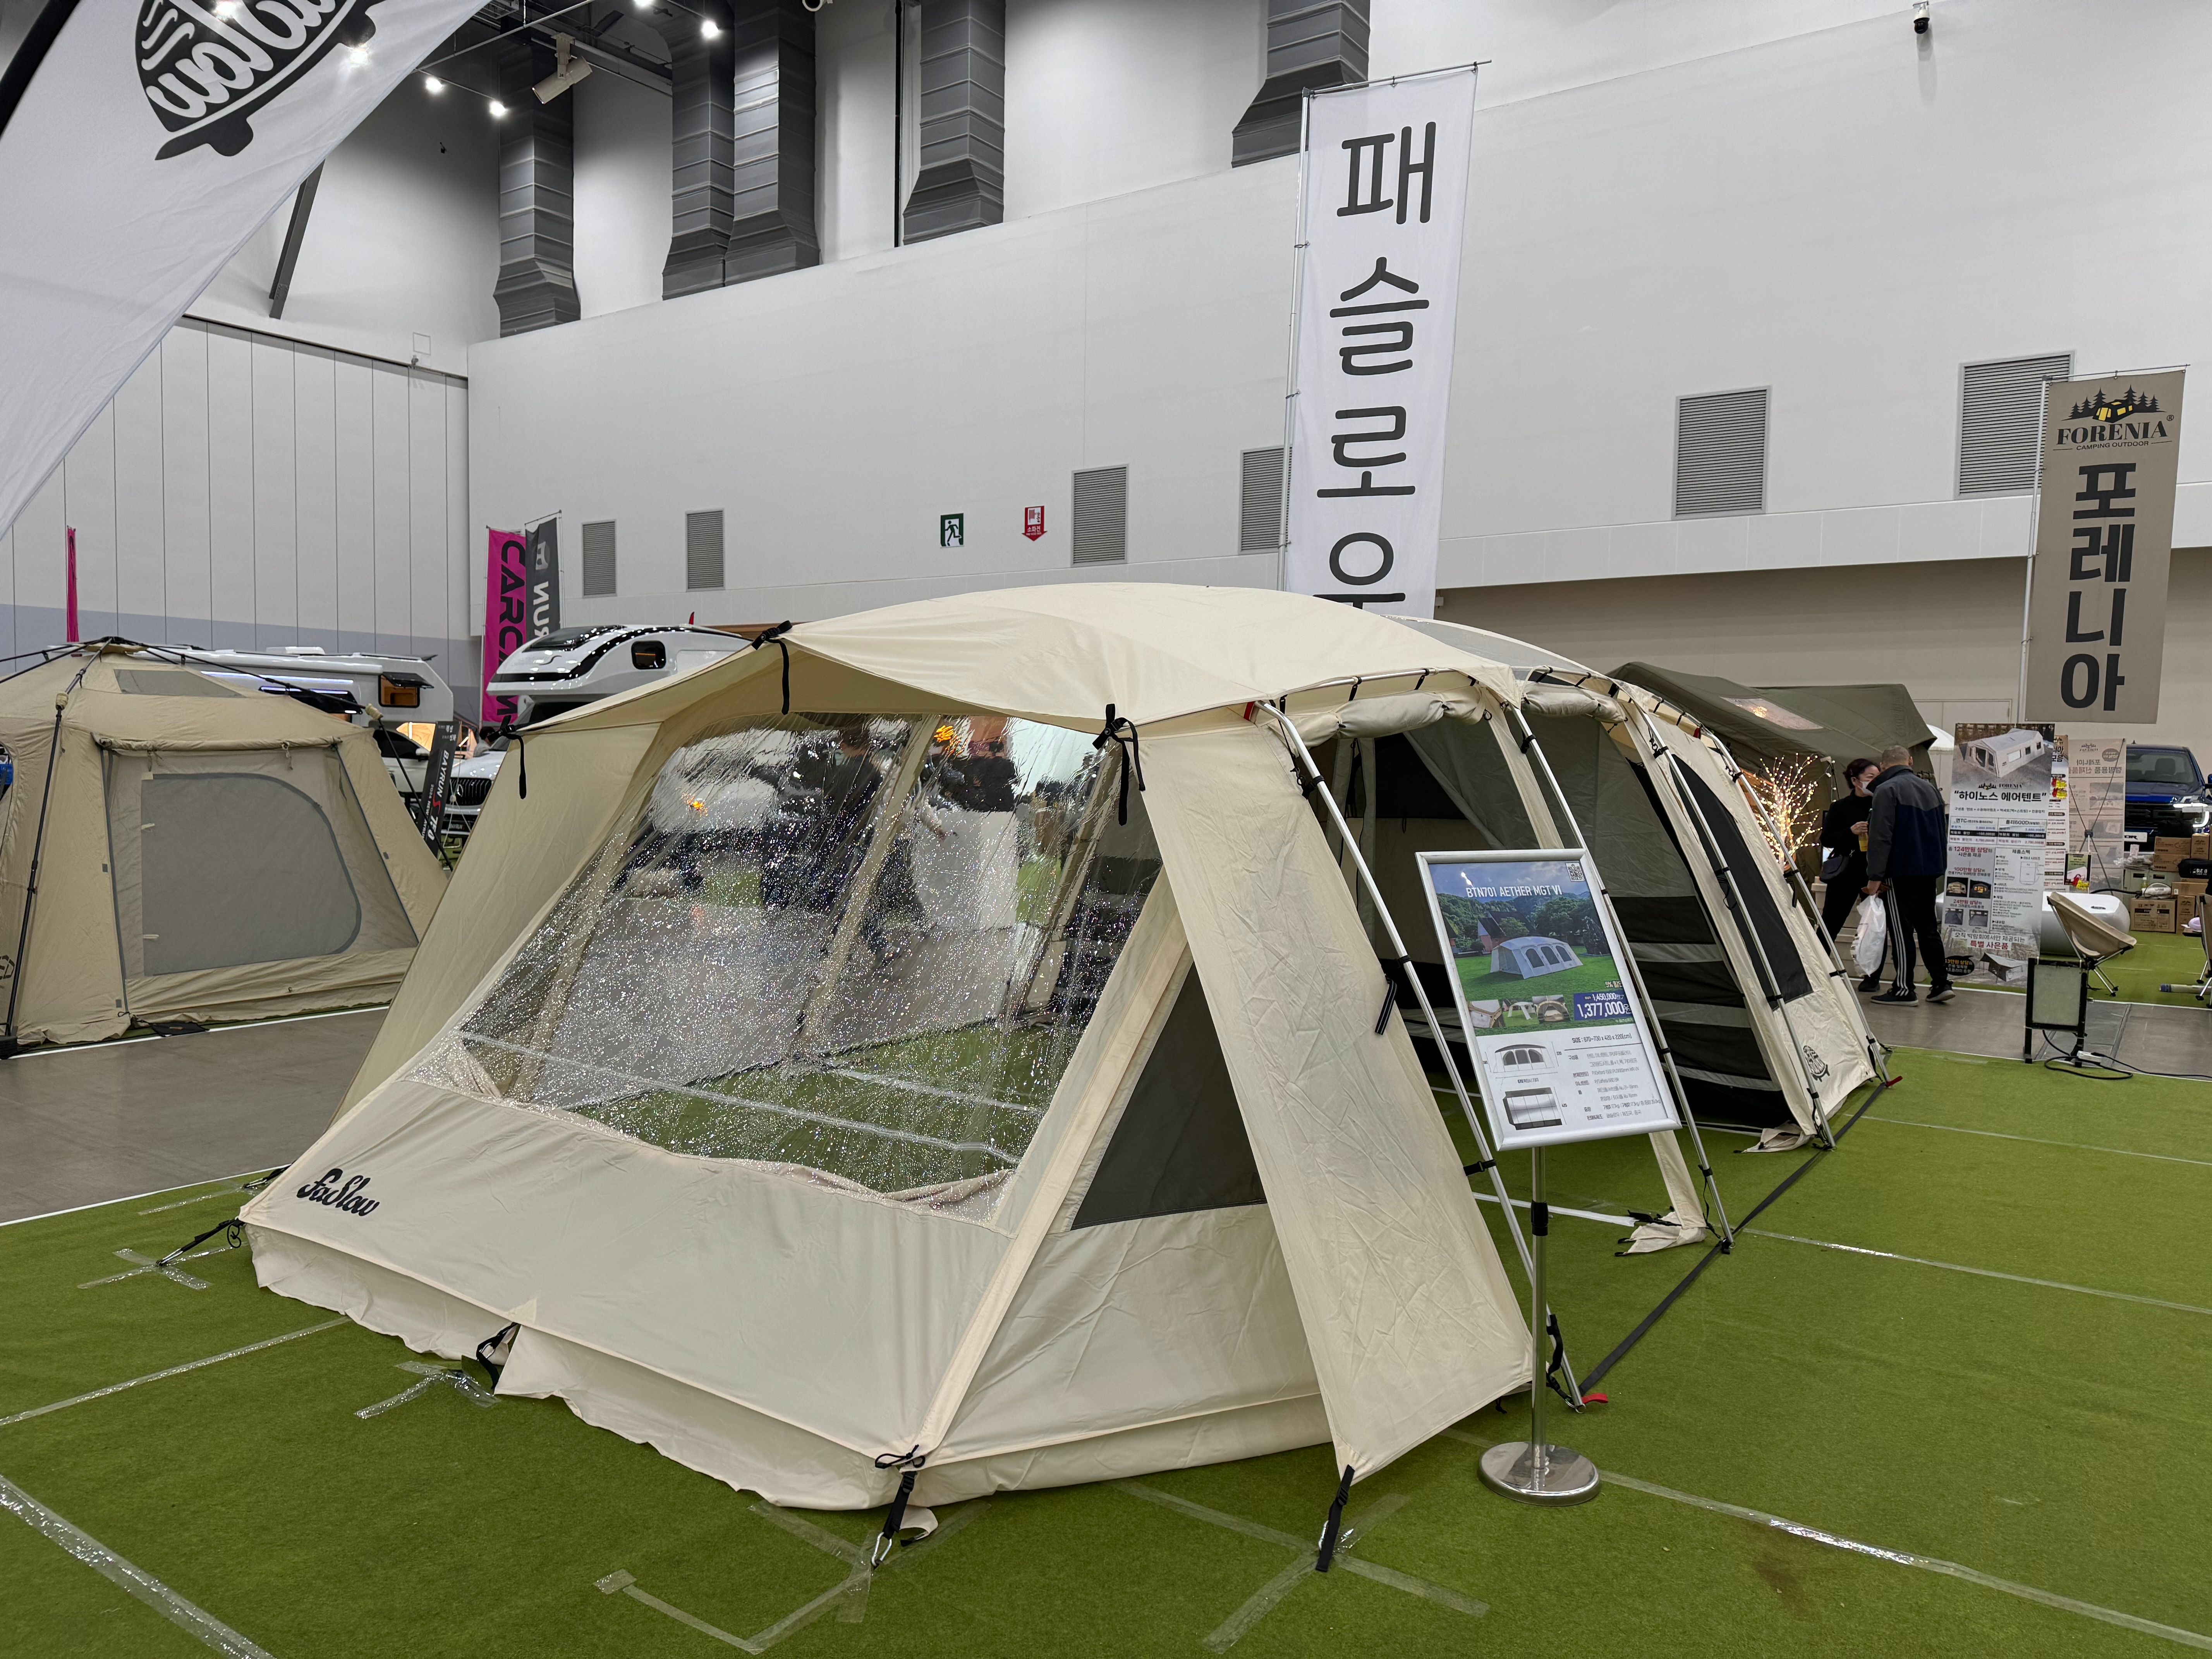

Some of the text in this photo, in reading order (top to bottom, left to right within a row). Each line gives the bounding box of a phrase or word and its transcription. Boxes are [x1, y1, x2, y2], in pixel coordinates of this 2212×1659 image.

[1312, 121, 1436, 611] 패슬로우
[2056, 421, 2168, 445] FORENIA
[2076, 440, 2149, 451] CAMPING OUTDOOR
[2061, 462, 2136, 711] 포레니아
[497, 540, 526, 716] CARCM
[437, 750, 449, 798] BAYRUN
[1466, 887, 1497, 897] BTN701
[1499, 886, 1531, 896] AETHER
[1534, 886, 1550, 895] MGT
[1967, 933, 2001, 941] 박람회에서만
[1970, 940, 2008, 950] 특별 사은품
